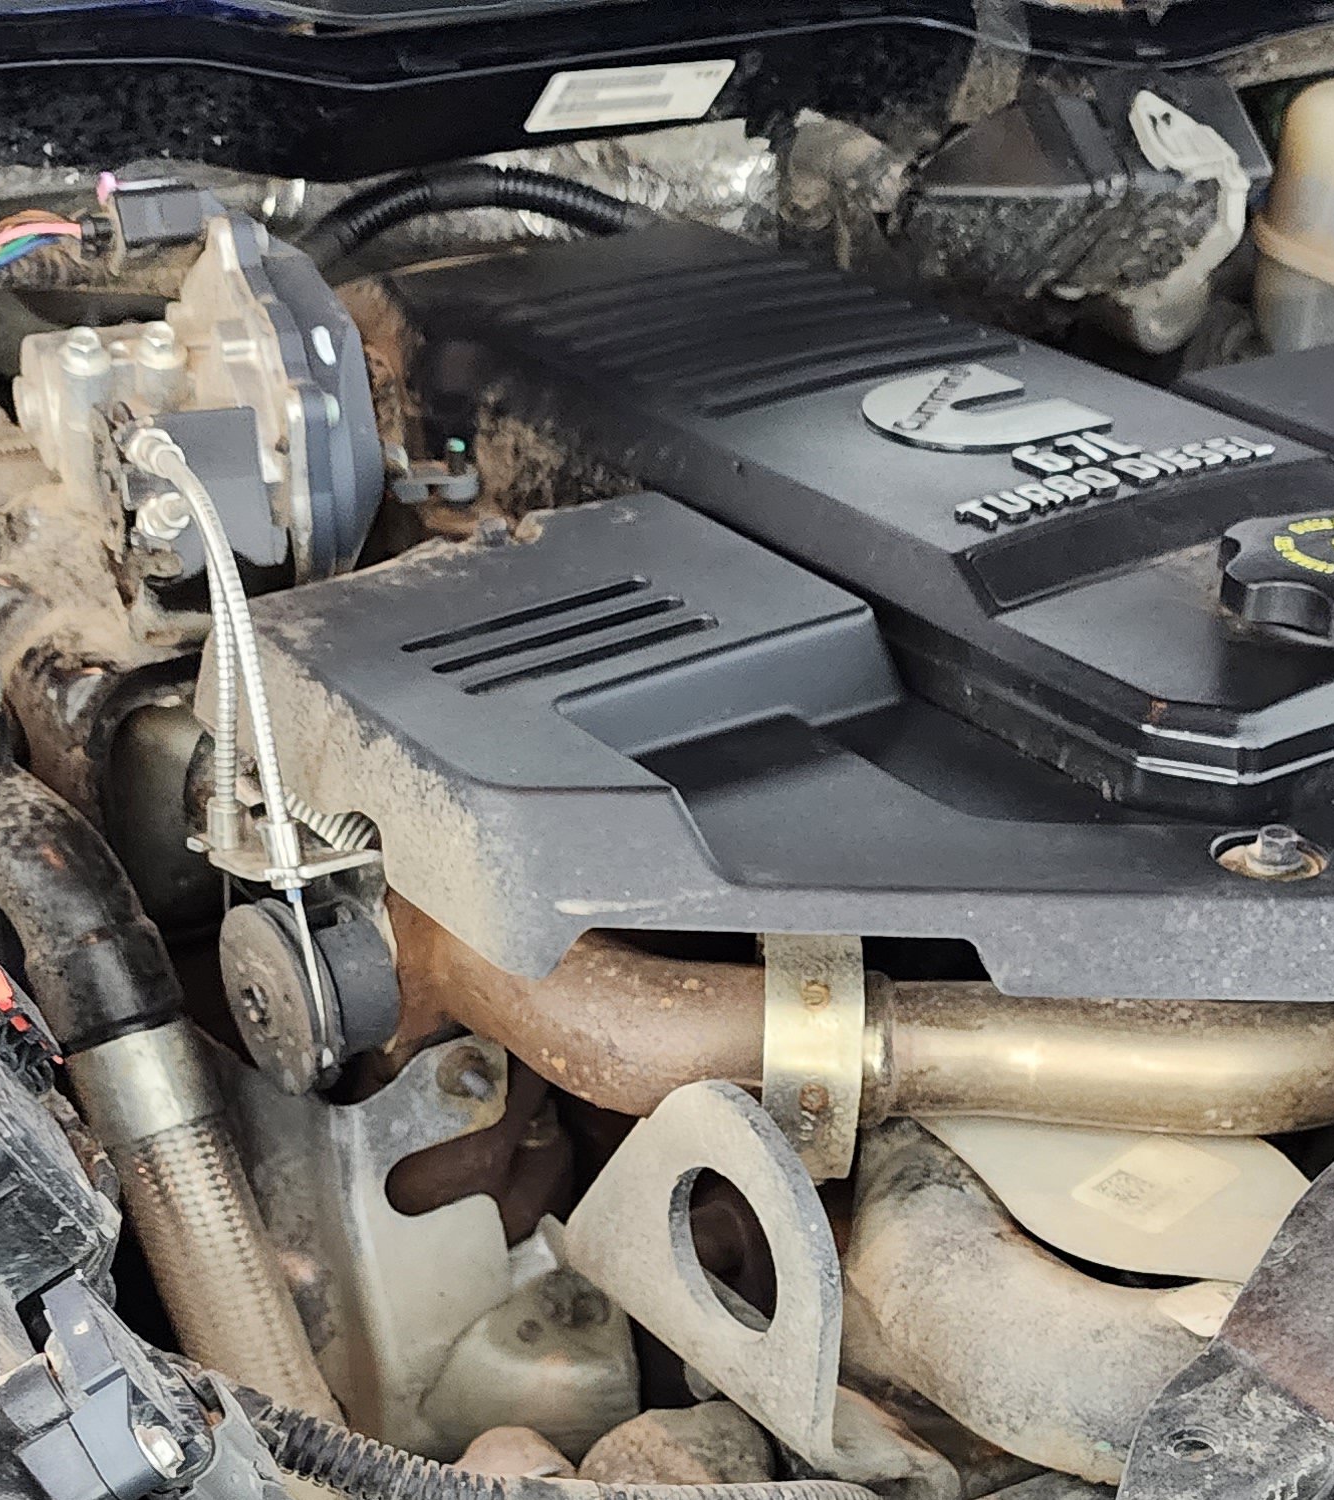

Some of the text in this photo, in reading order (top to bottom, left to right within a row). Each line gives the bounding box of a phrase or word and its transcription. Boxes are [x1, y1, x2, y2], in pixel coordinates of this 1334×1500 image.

[954, 435, 1277, 528] TURBO DIESEL
[1012, 431, 1143, 475] 6.7L
